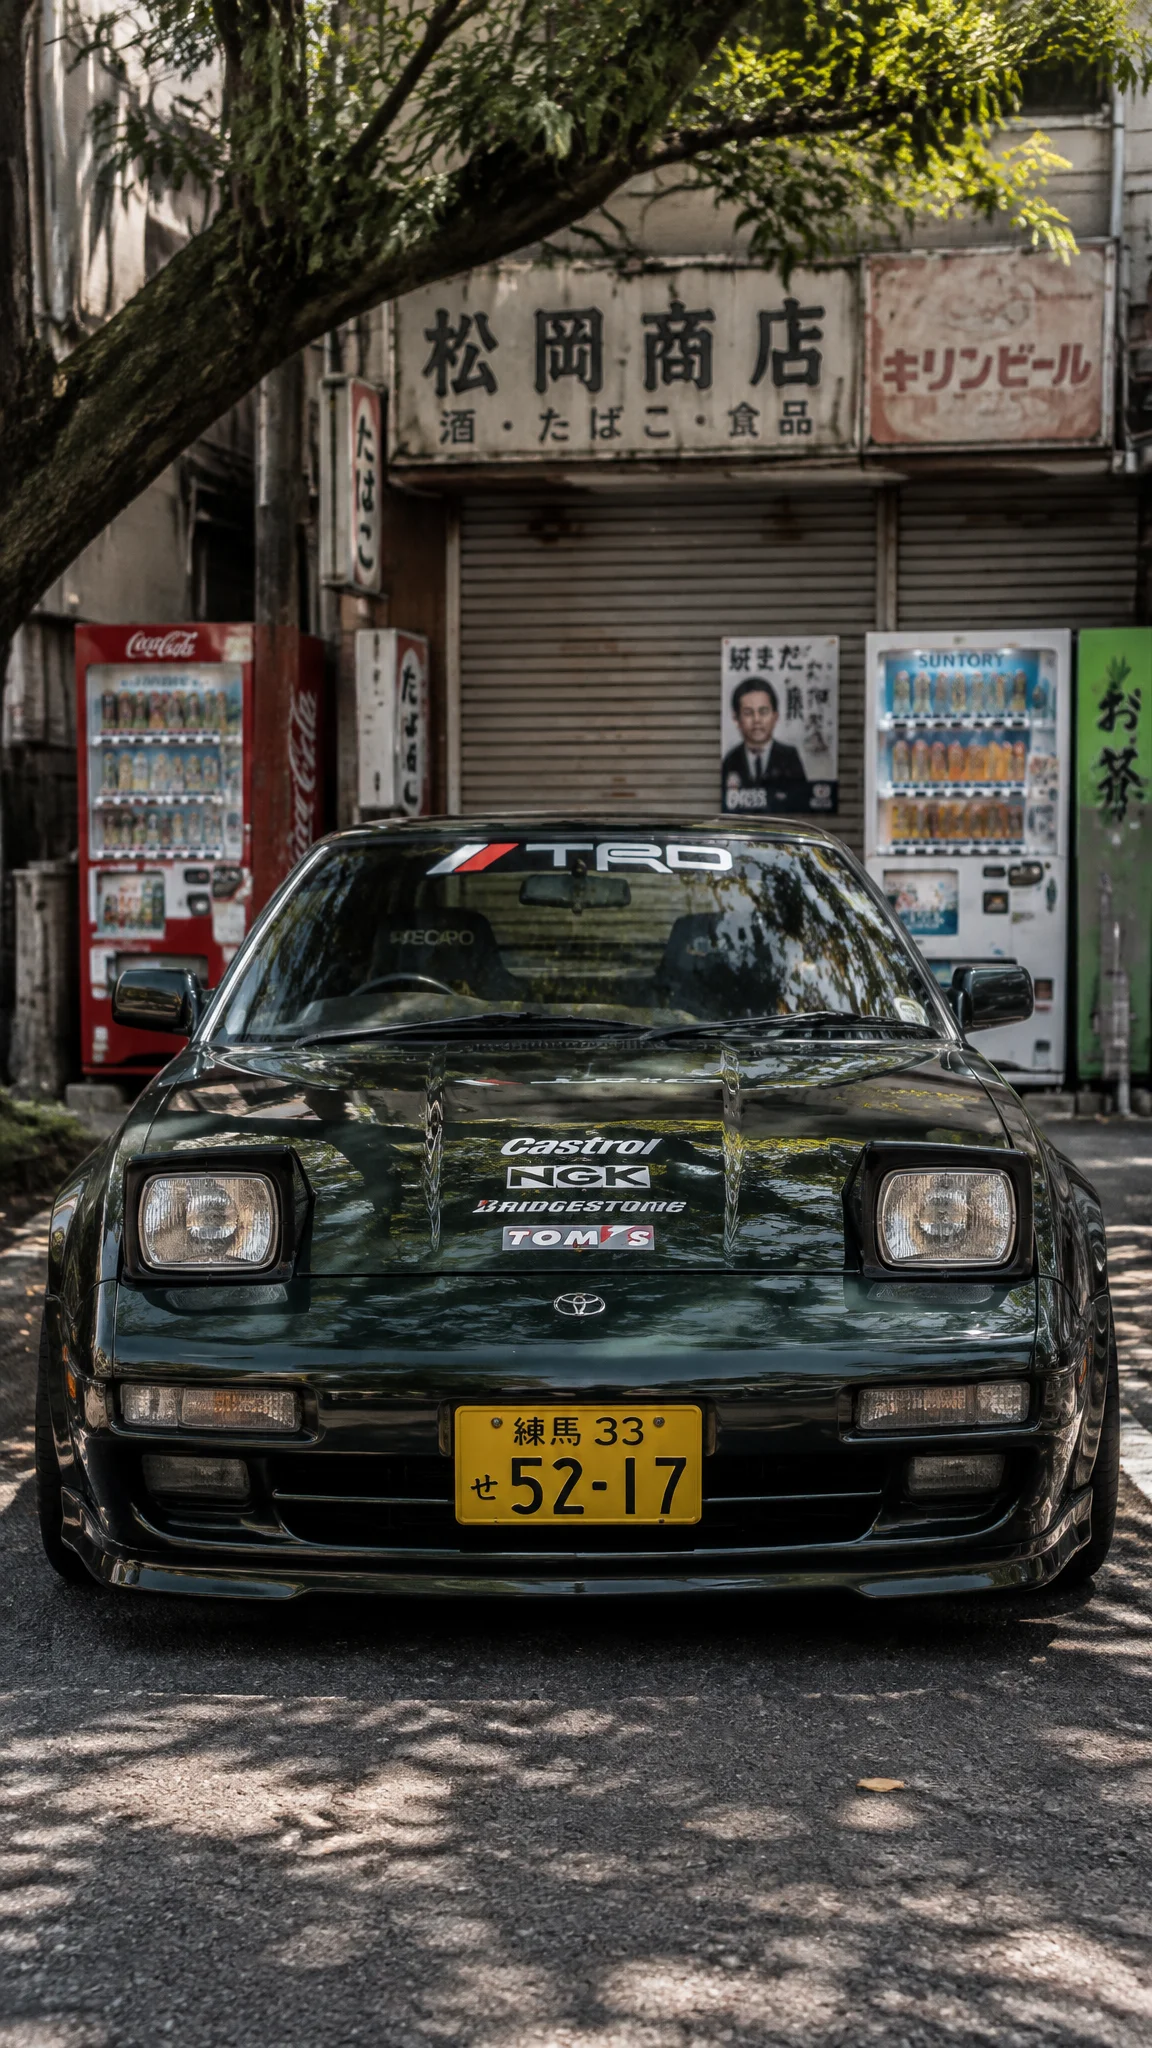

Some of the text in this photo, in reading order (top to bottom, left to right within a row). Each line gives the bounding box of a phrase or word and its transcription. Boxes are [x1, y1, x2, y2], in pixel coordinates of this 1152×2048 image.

[422, 299, 825, 398] 松岡商店
[883, 344, 1092, 393] キリンビール
[918, 653, 1004, 668] SUNTORY
[525, 842, 733, 873] TRD
[500, 1137, 662, 1156] Castrol
[507, 1164, 650, 1188] NGK
[472, 1199, 687, 1213] BRIDGESTONE
[513, 1416, 645, 1447] 練馬 33
[470, 1456, 687, 1515] せ 52-17
